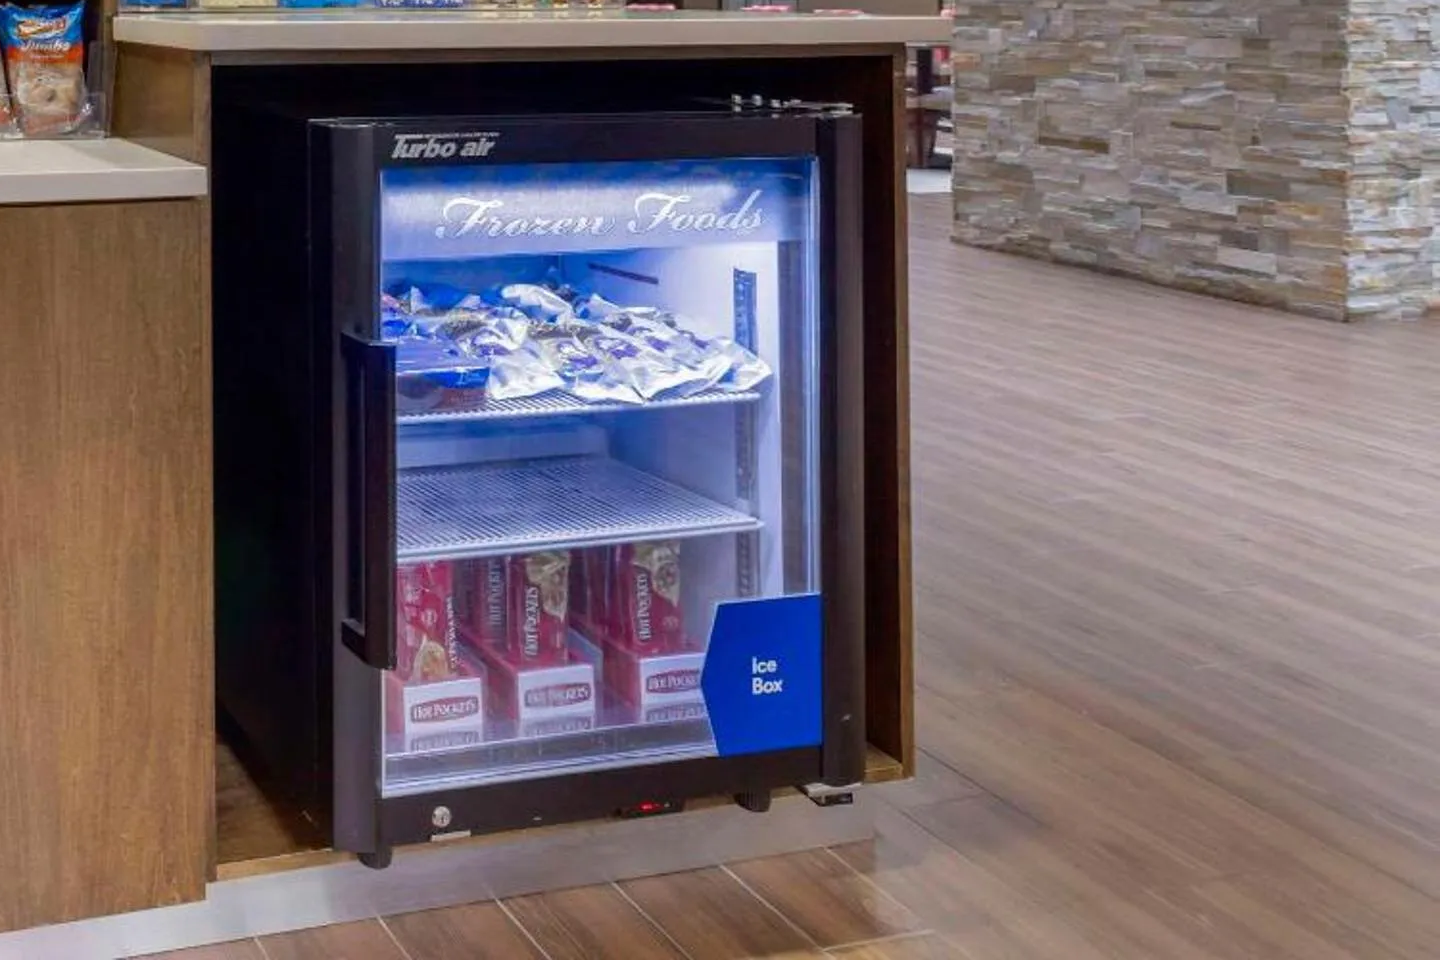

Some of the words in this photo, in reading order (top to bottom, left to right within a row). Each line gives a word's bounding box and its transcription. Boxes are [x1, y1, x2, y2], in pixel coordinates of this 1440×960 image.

[391, 134, 457, 159] Turbo
[459, 137, 496, 157] air
[434, 196, 617, 239] Frozen
[626, 188, 763, 234] Foods
[751, 656, 778, 674] Ice
[751, 677, 783, 695] Box
[413, 704, 434, 720] HOT
[433, 698, 478, 717] POCKETS
